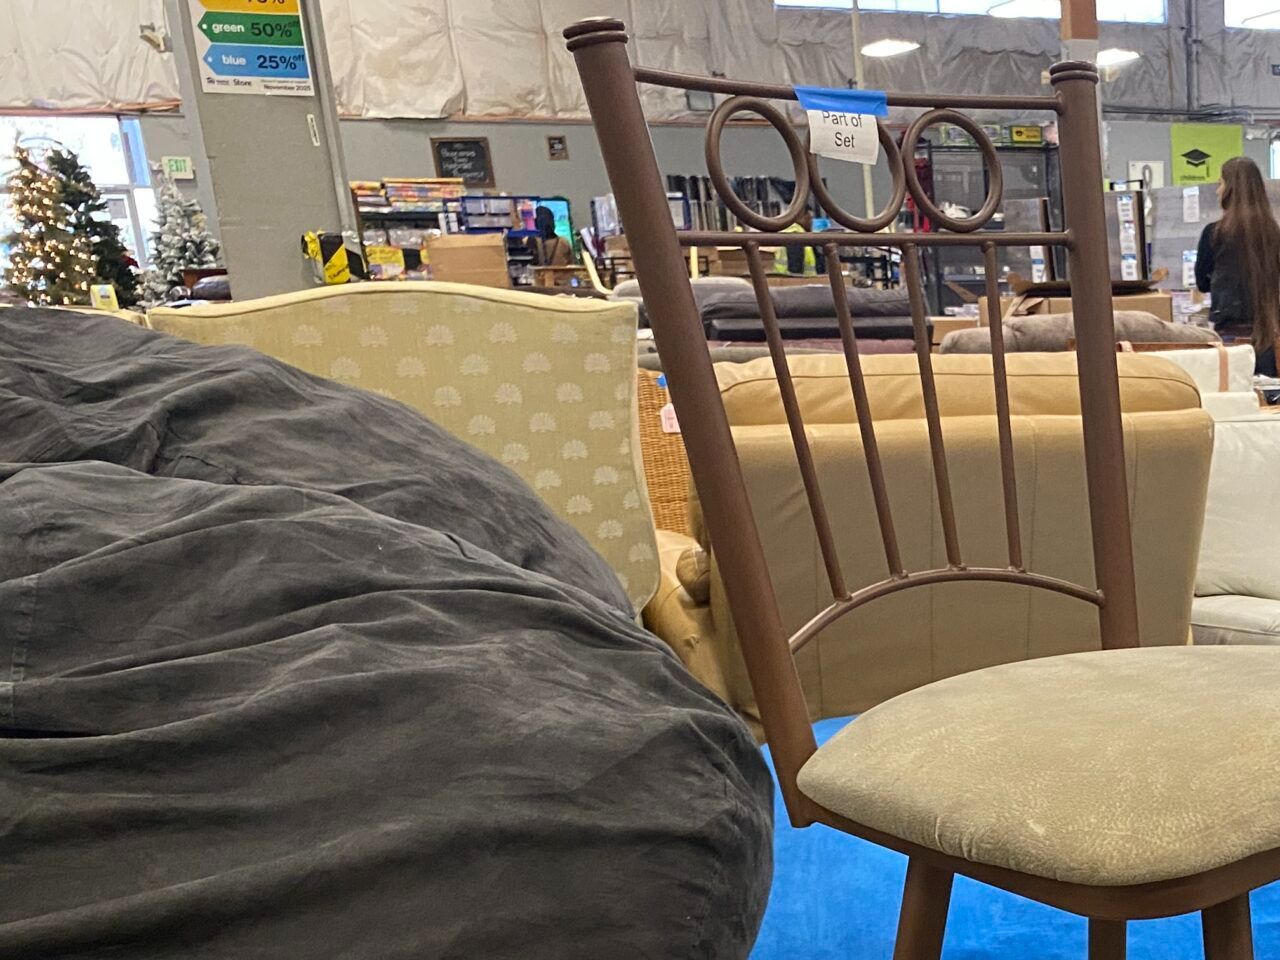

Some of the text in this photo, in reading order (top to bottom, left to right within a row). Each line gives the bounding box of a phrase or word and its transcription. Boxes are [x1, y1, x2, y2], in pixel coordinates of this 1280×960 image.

[212, 23, 245, 33] green
[251, 22, 293, 38] 50%
[222, 54, 247, 66] blue
[256, 54, 297, 70] 25%
[822, 111, 863, 128] Part of
[834, 131, 856, 149] Set
[168, 159, 187, 172] EXIT
